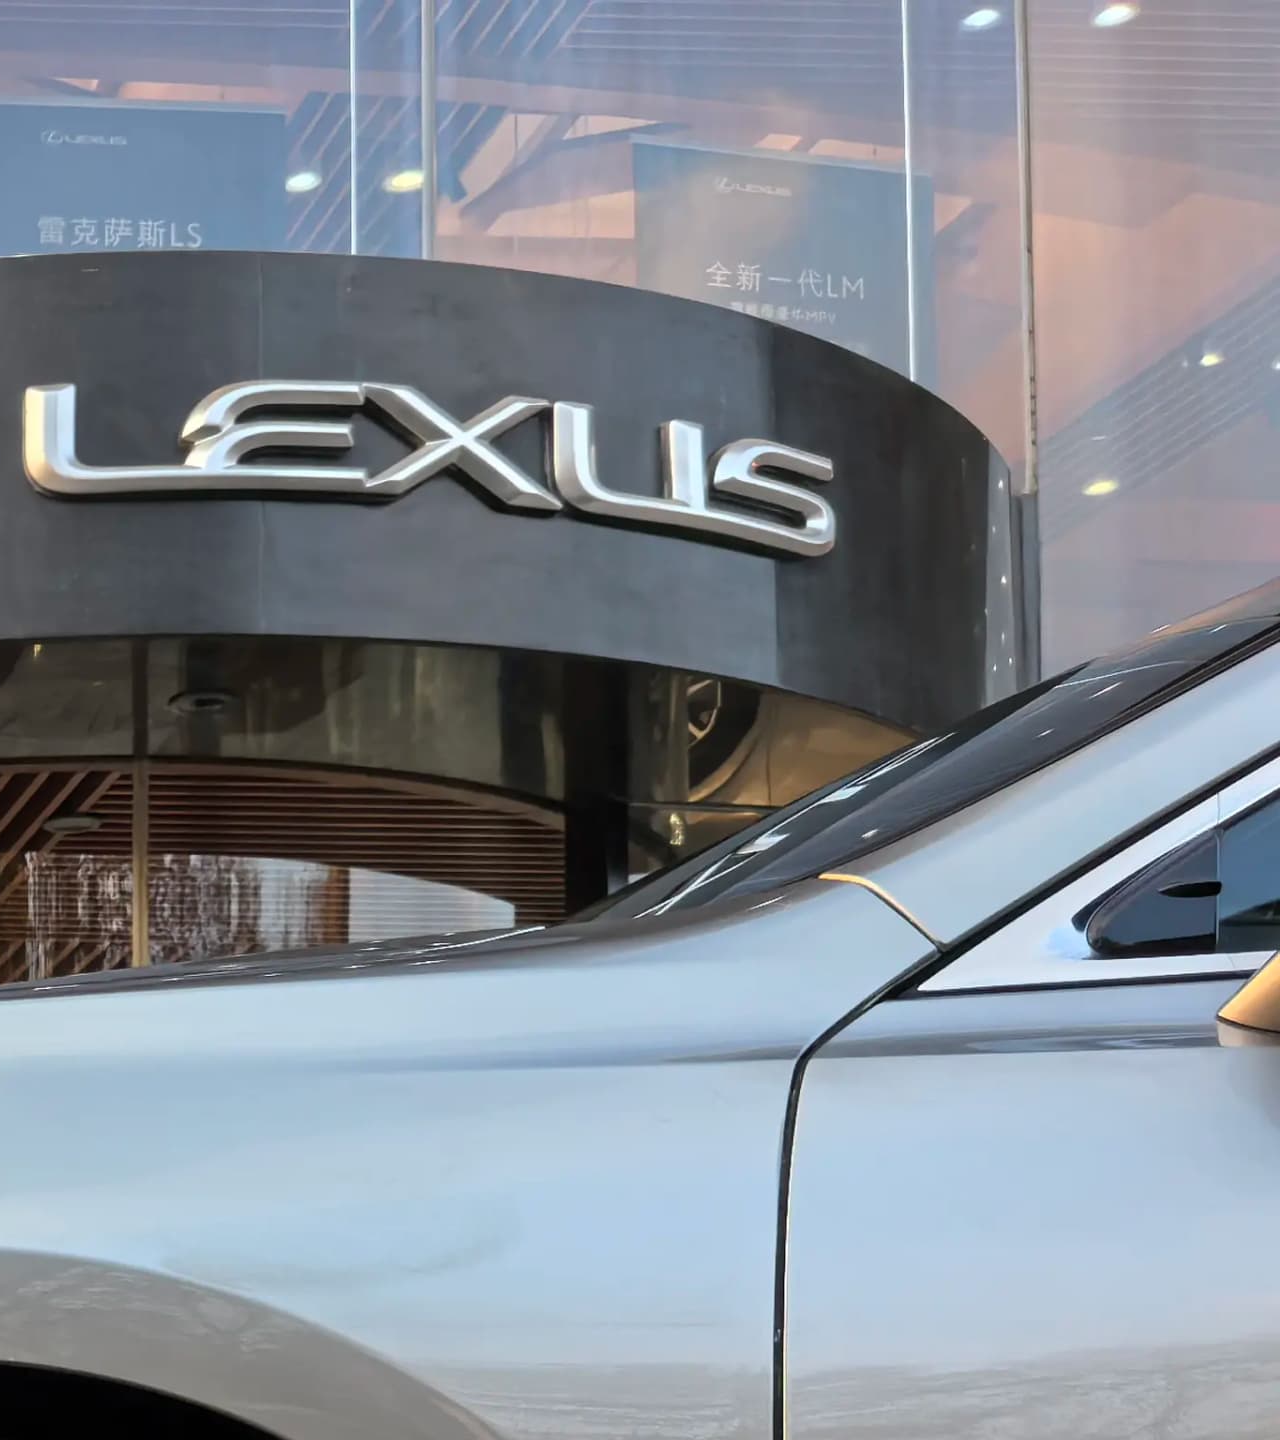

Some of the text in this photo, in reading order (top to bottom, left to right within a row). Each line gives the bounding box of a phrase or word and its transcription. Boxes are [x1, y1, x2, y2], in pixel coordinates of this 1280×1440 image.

[37, 216, 203, 248] 雷克萨斯LS
[705, 260, 864, 300] 全新一代LM
[24, 378, 836, 557] LEXUS
